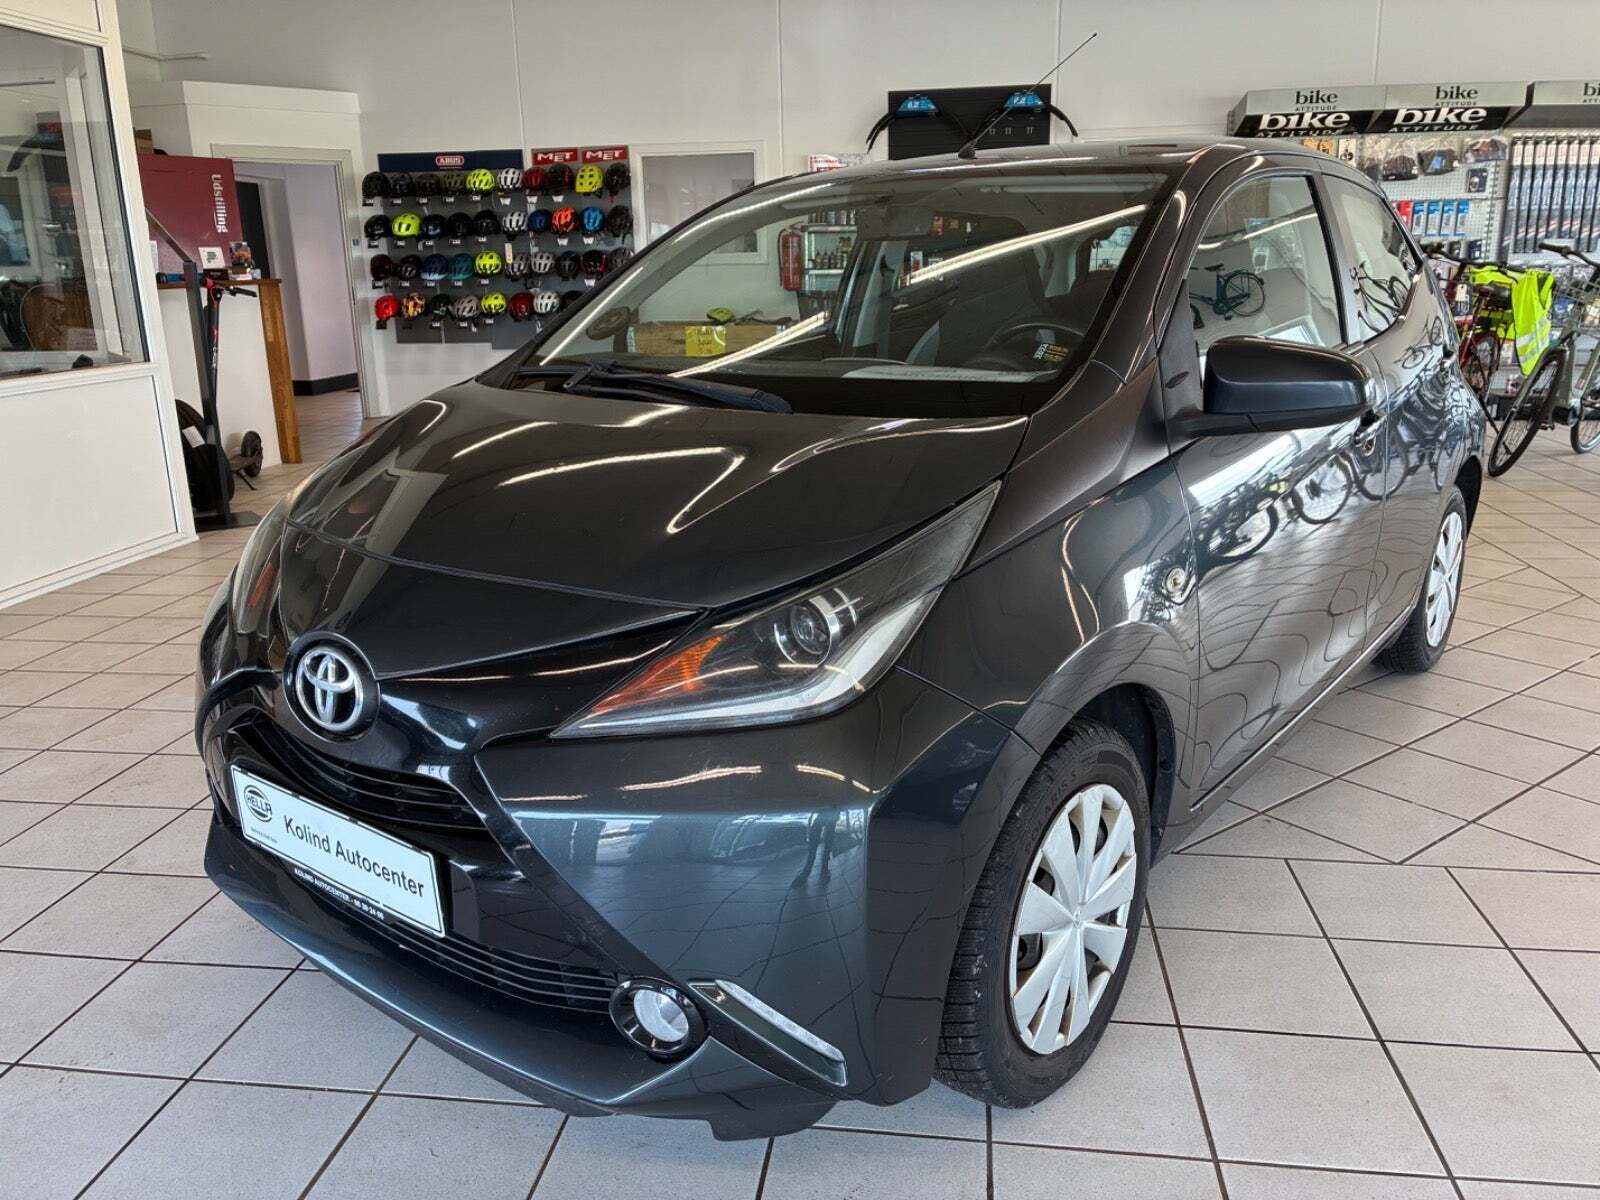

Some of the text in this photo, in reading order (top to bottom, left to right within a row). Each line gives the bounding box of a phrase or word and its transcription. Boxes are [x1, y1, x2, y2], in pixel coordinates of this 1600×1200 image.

[1295, 90, 1338, 105] bike
[1435, 86, 1478, 100] bike
[1259, 112, 1350, 130] bike
[1394, 108, 1487, 124] bike
[1388, 124, 1480, 133] ATTITUDE
[537, 151, 574, 162] MET
[585, 150, 623, 161] MET
[211, 173, 229, 233] Udstilling
[283, 815, 424, 898] Kolind Autocenter
